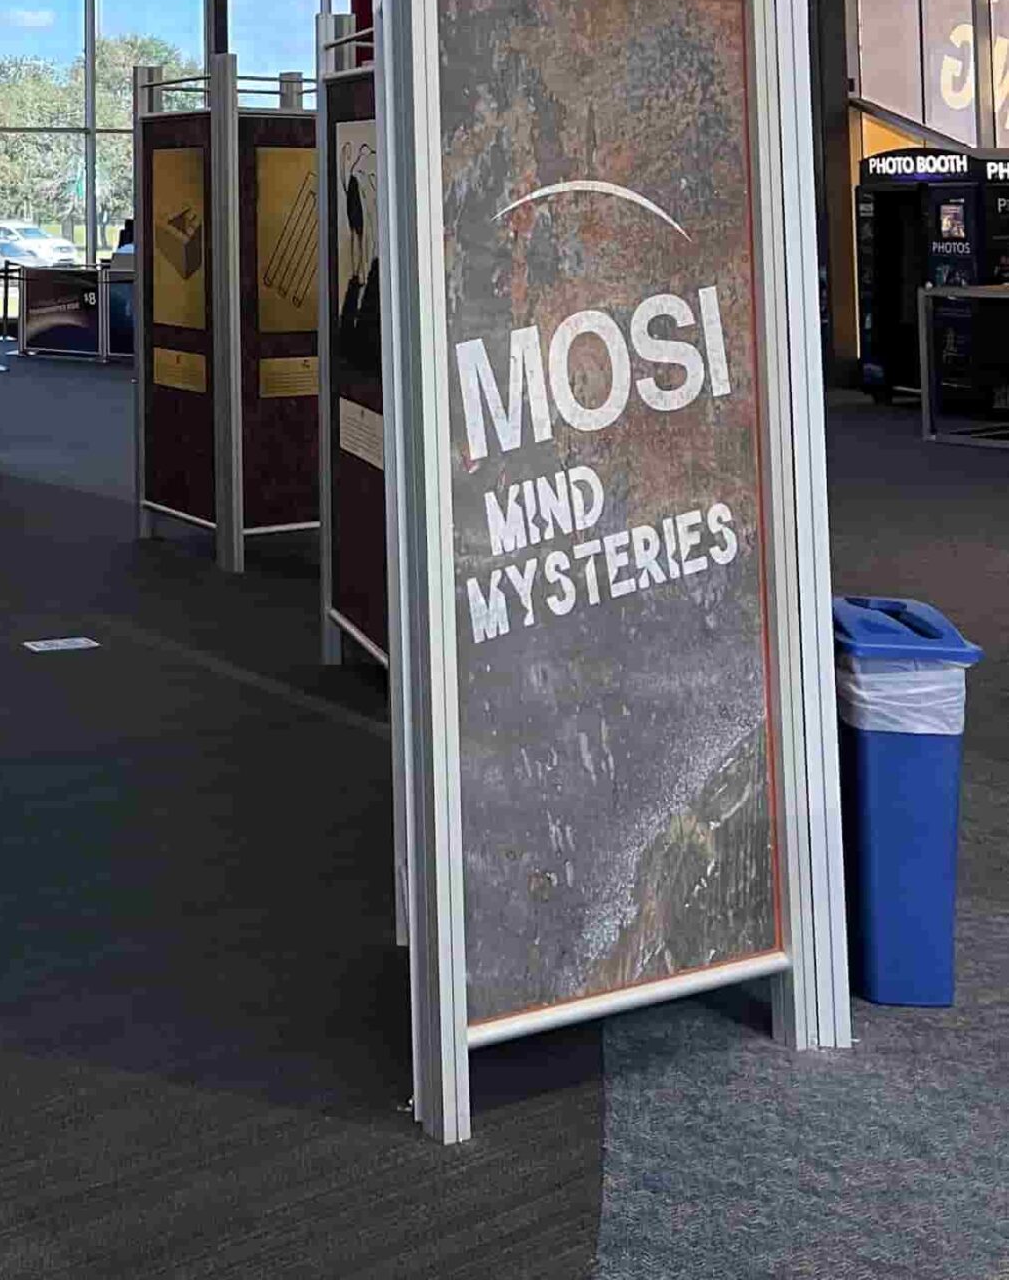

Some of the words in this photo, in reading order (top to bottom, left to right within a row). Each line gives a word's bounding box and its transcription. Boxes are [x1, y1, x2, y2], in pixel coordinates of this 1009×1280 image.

[868, 156, 914, 175] PHOTO
[916, 154, 968, 174] BOOTH
[932, 241, 971, 254] PHOTOS
[455, 285, 732, 460] MOSI
[484, 465, 605, 556] MIND
[466, 503, 739, 644] MYSTERIES
